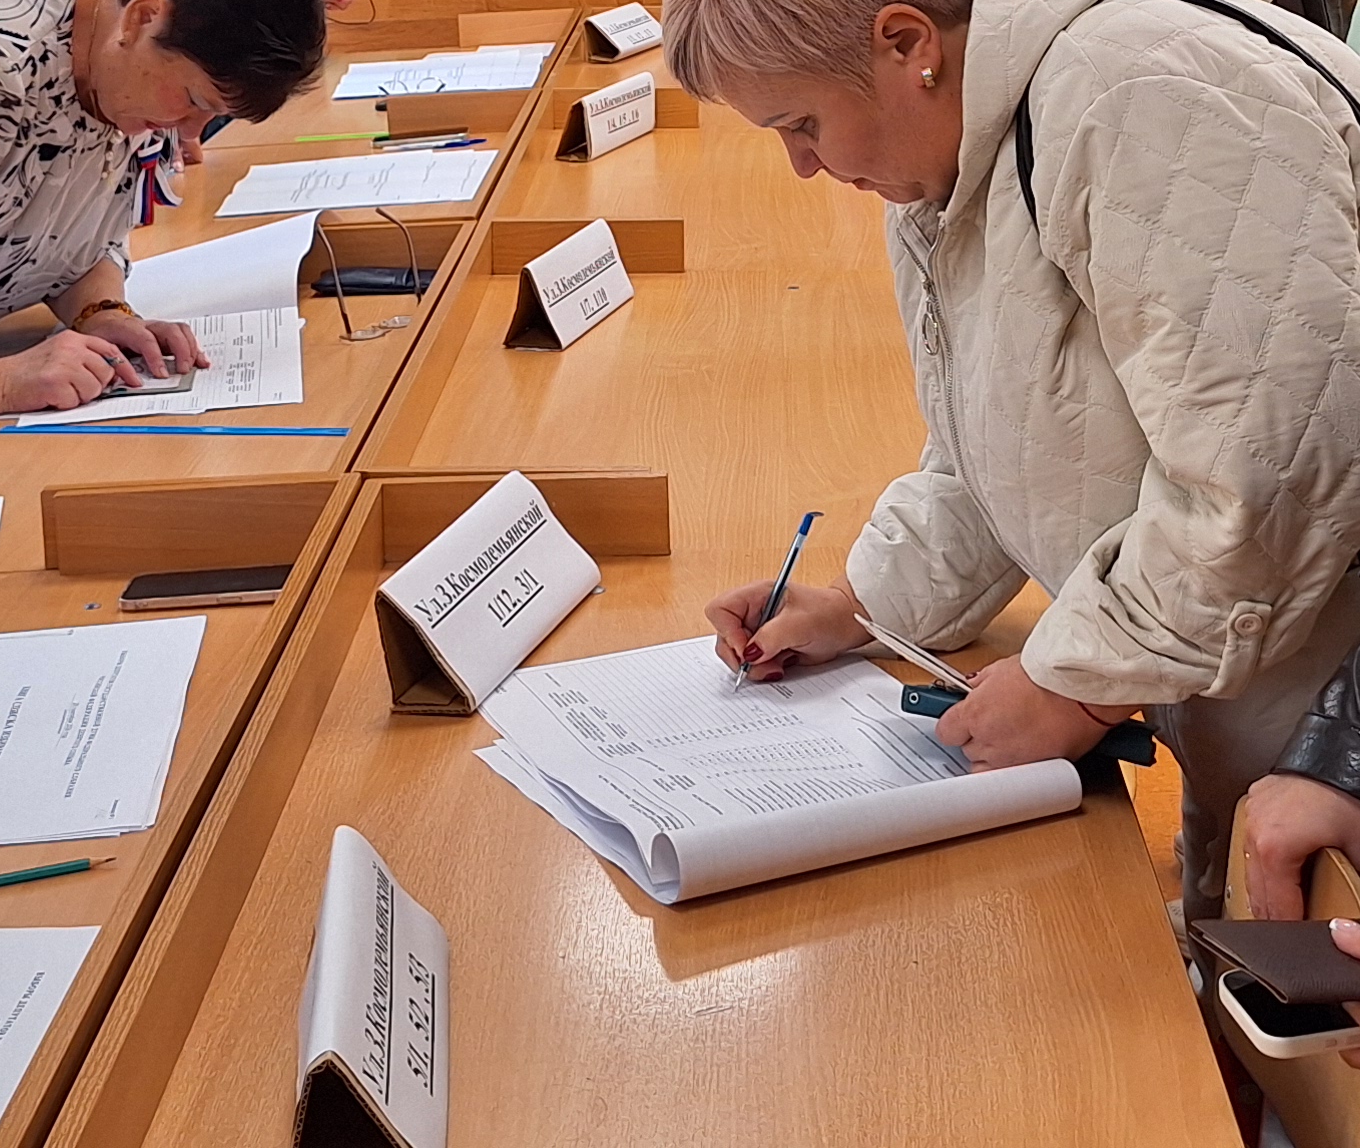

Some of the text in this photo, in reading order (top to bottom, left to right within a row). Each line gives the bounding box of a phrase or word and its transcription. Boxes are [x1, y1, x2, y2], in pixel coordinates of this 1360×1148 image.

[414, 500, 544, 622] Ул.З.Космодемьянской
[488, 568, 540, 622] 1/12, 3/1
[361, 861, 390, 1095] Ул.З.Космодемьянской
[408, 998, 429, 1042] 5/2
